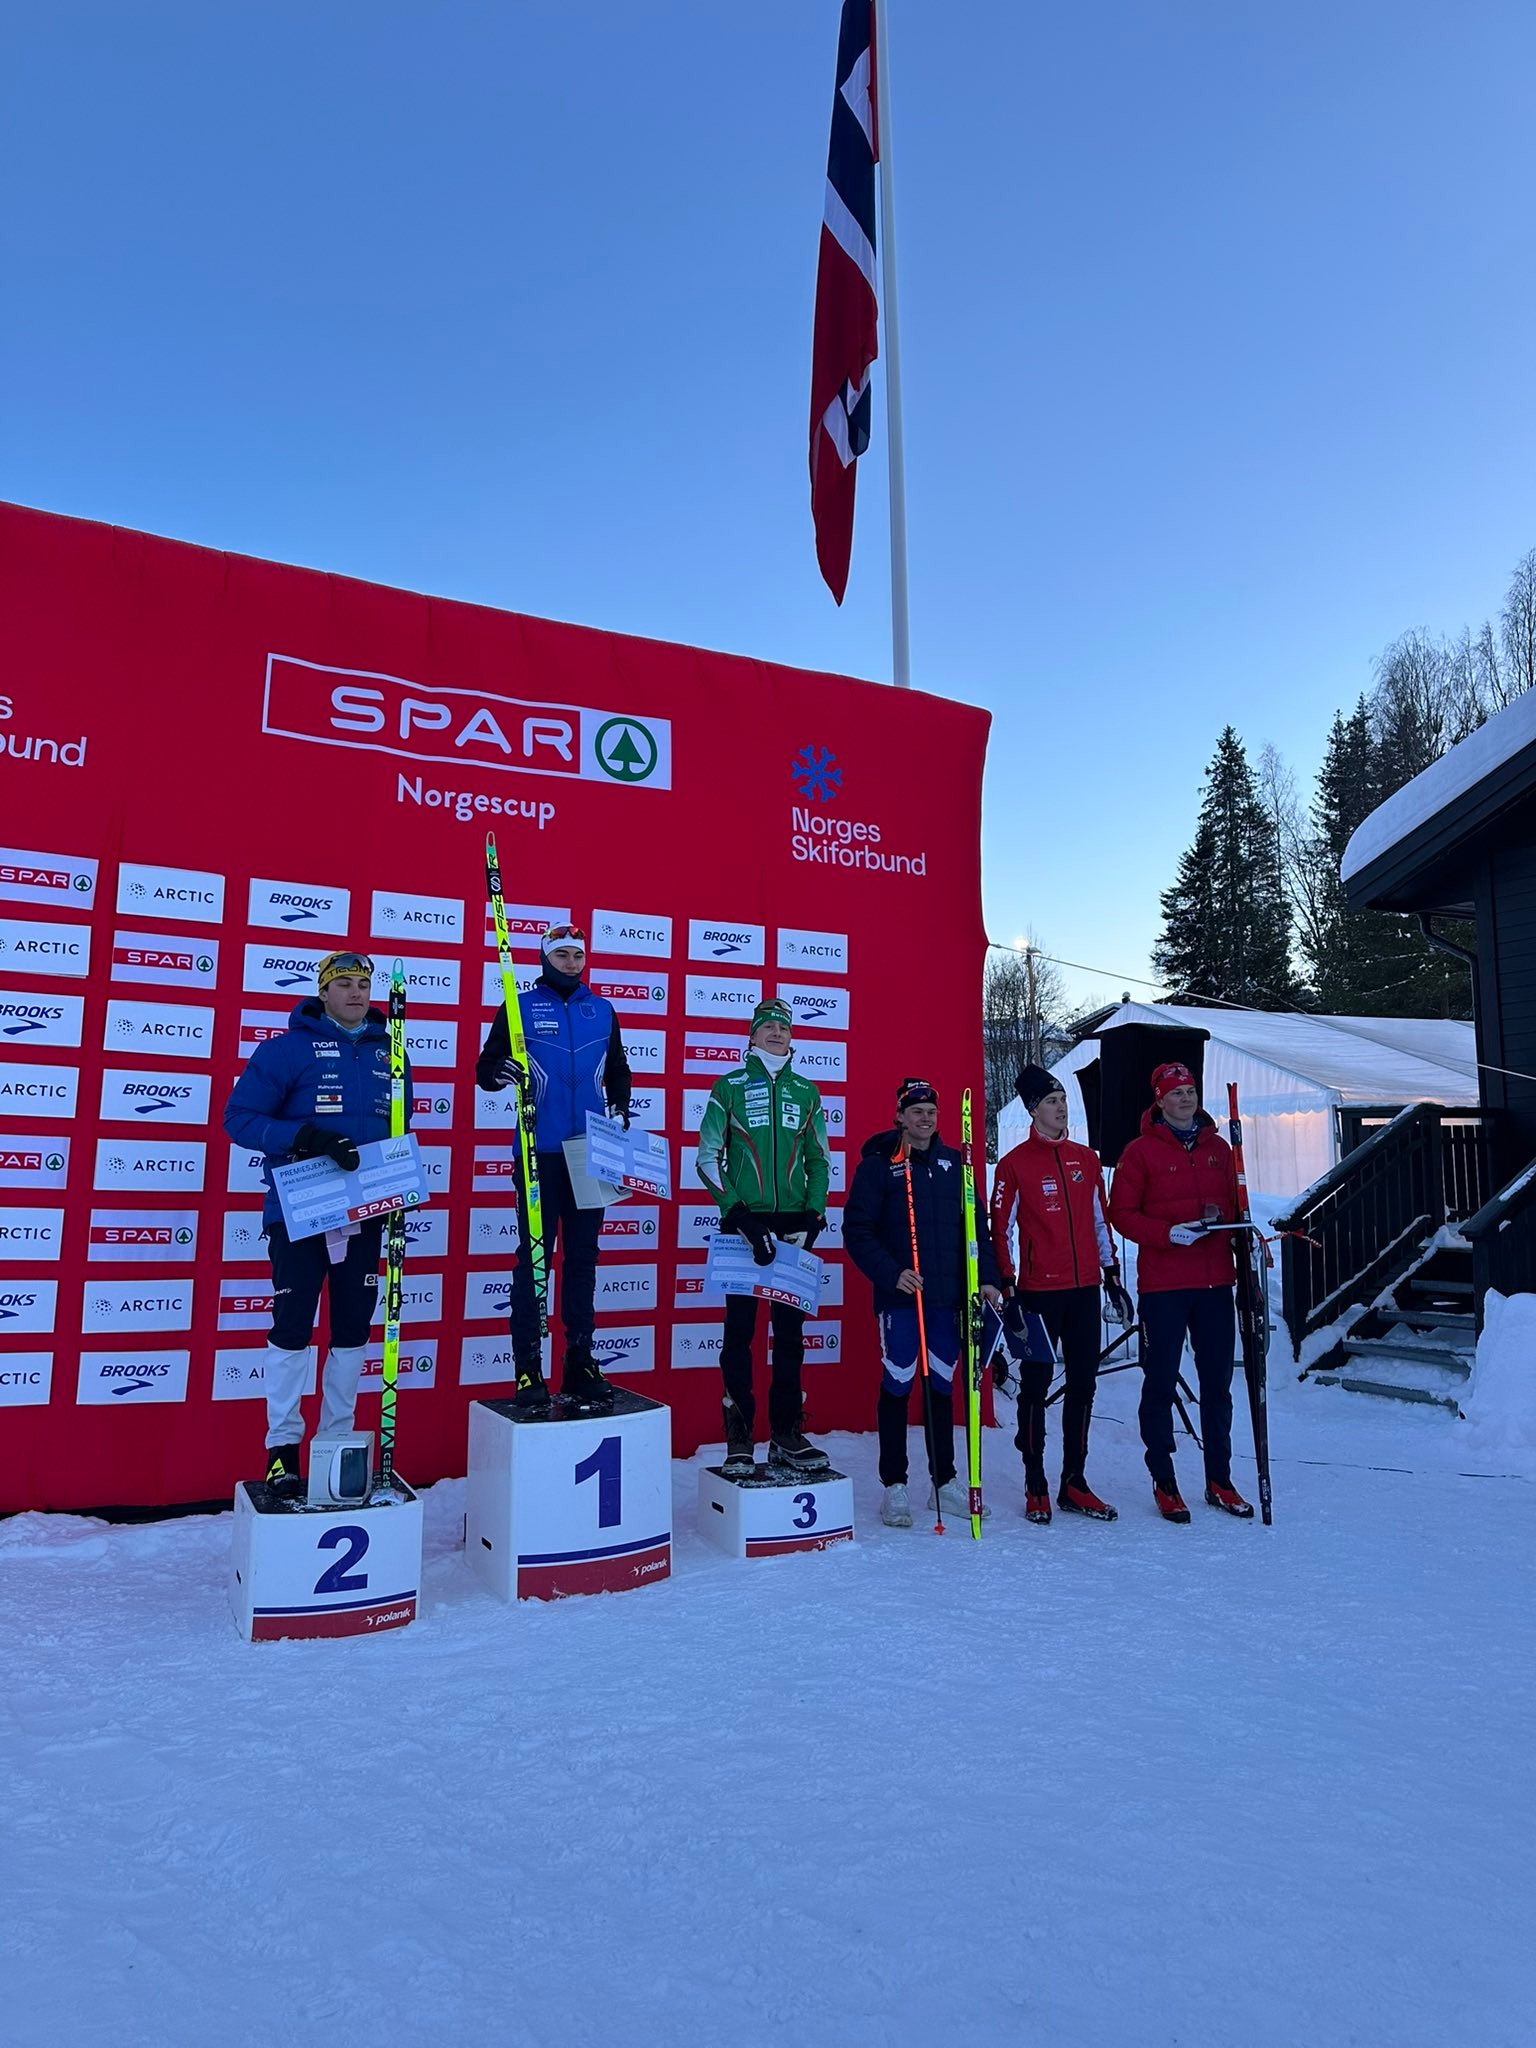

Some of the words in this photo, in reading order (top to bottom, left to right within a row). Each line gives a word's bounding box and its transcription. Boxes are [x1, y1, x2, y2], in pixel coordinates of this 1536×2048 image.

[330, 685, 573, 761] SPAR
[397, 772, 555, 830] Norgescup
[792, 806, 881, 844] Norges
[791, 835, 926, 876] Skiforbund
[0, 868, 68, 887] SPAR
[153, 887, 215, 904] ARCTIC
[269, 892, 333, 911] BROOKS
[403, 911, 456, 926] ARCTIC
[504, 919, 549, 932] PAR
[619, 927, 665, 942] ARCTIC
[703, 930, 752, 944] BROOKS
[14, 939, 80, 955] ARCTIC
[801, 945, 842, 957] ARCTIC
[126, 951, 191, 968] SPAR
[262, 958, 320, 973] BROOK
[513, 981, 538, 992] ARC
[600, 985, 648, 998] SPAR
[711, 992, 755, 1004] ARCTIC
[792, 995, 838, 1009] BROOKS
[141, 1022, 203, 1038] ARCTIC
[406, 1037, 449, 1050] RCTIC
[621, 1045, 658, 1058] RCTIC
[695, 1047, 740, 1060] SPAR
[799, 1055, 840, 1067] ARCTIC
[1, 1083, 67, 1098] ARCTIC
[122, 1083, 193, 1099] BROOKS
[133, 1160, 195, 1172] ARCTIC
[629, 1178, 657, 1193] SPAR
[995, 1180, 1006, 1209] LYN
[357, 1196, 403, 1218] SPAR
[602, 1222, 639, 1233] PAR
[105, 1229, 170, 1242] SPAR
[482, 1283, 511, 1295] BRO
[602, 1280, 650, 1293] ARCTIC
[762, 1287, 800, 1306] SPAR
[120, 1298, 183, 1312] ARCTIC
[233, 1299, 274, 1311] SPA
[698, 1339, 723, 1351] ARC
[100, 1364, 171, 1377] BROOKS
[575, 1435, 622, 1528] 1
[792, 1491, 818, 1529] 3
[313, 1525, 370, 1594] 2
[641, 1558, 668, 1574] polanik
[376, 1608, 411, 1625] polanik
